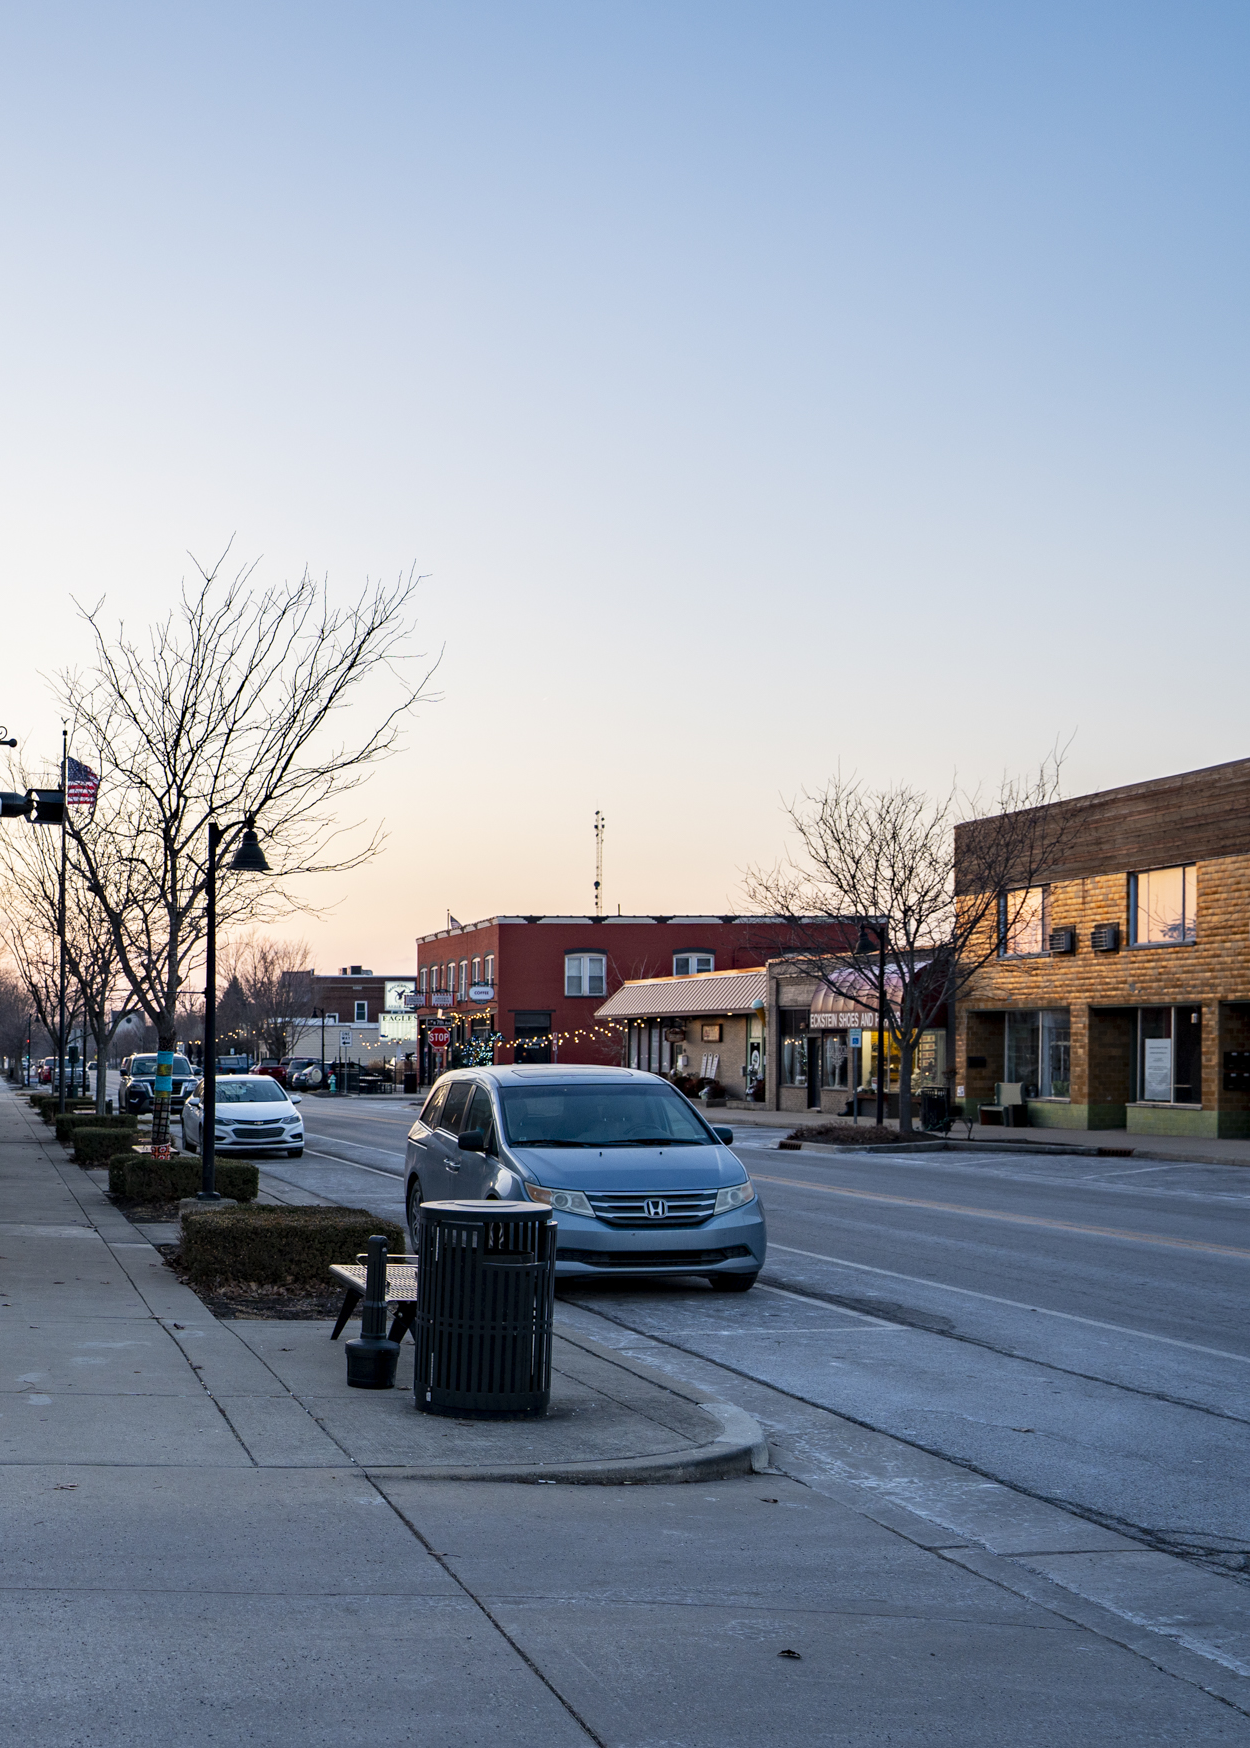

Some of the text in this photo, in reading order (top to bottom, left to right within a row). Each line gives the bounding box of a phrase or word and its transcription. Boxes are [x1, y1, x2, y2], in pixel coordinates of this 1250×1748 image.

[382, 1014, 418, 1022] EAGLES
[810, 1013, 838, 1027] ECKSTEIN
[838, 1012, 859, 1027] SHOES
[860, 1012, 874, 1027] AND
[429, 1033, 449, 1042] STOP
